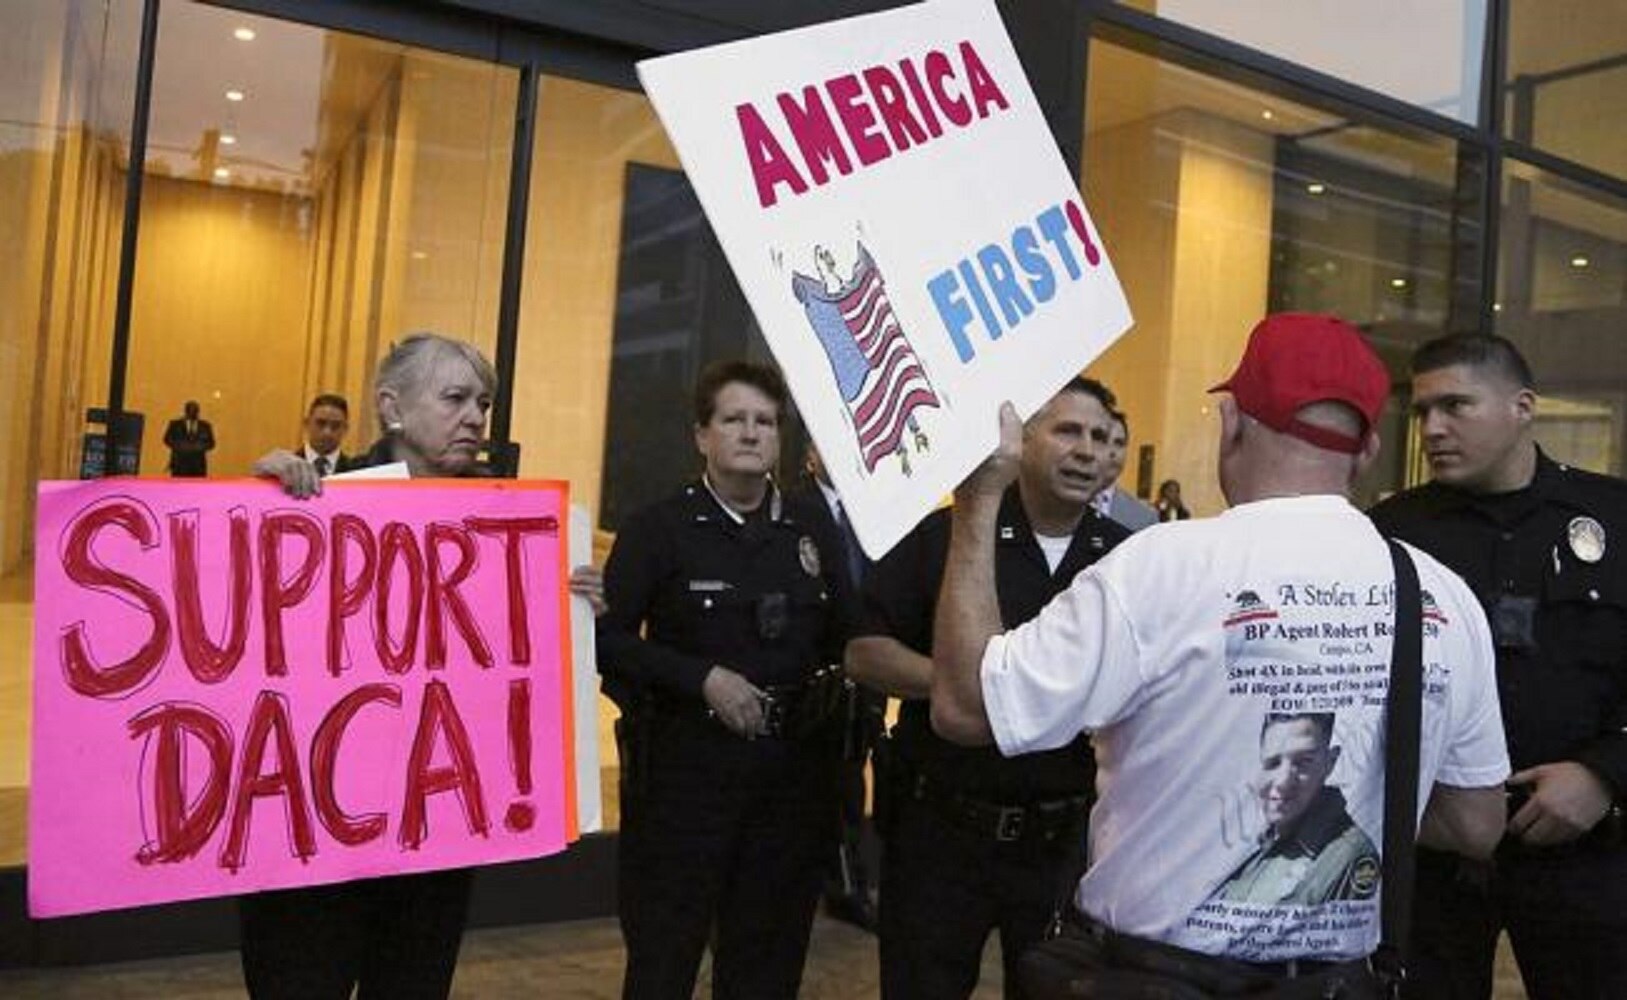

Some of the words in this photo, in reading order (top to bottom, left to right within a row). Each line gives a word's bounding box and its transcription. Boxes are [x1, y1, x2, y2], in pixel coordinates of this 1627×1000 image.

[736, 40, 1011, 208] AMERICA
[926, 199, 1101, 364] FIRST!
[60, 495, 558, 700] SUPPORT
[1244, 623, 1271, 640] BP
[1274, 623, 1320, 642] Agent
[1322, 622, 1369, 639] Robert
[1278, 583, 1299, 606] A
[1364, 583, 1396, 616] Lif
[127, 678, 537, 876] DACA!
